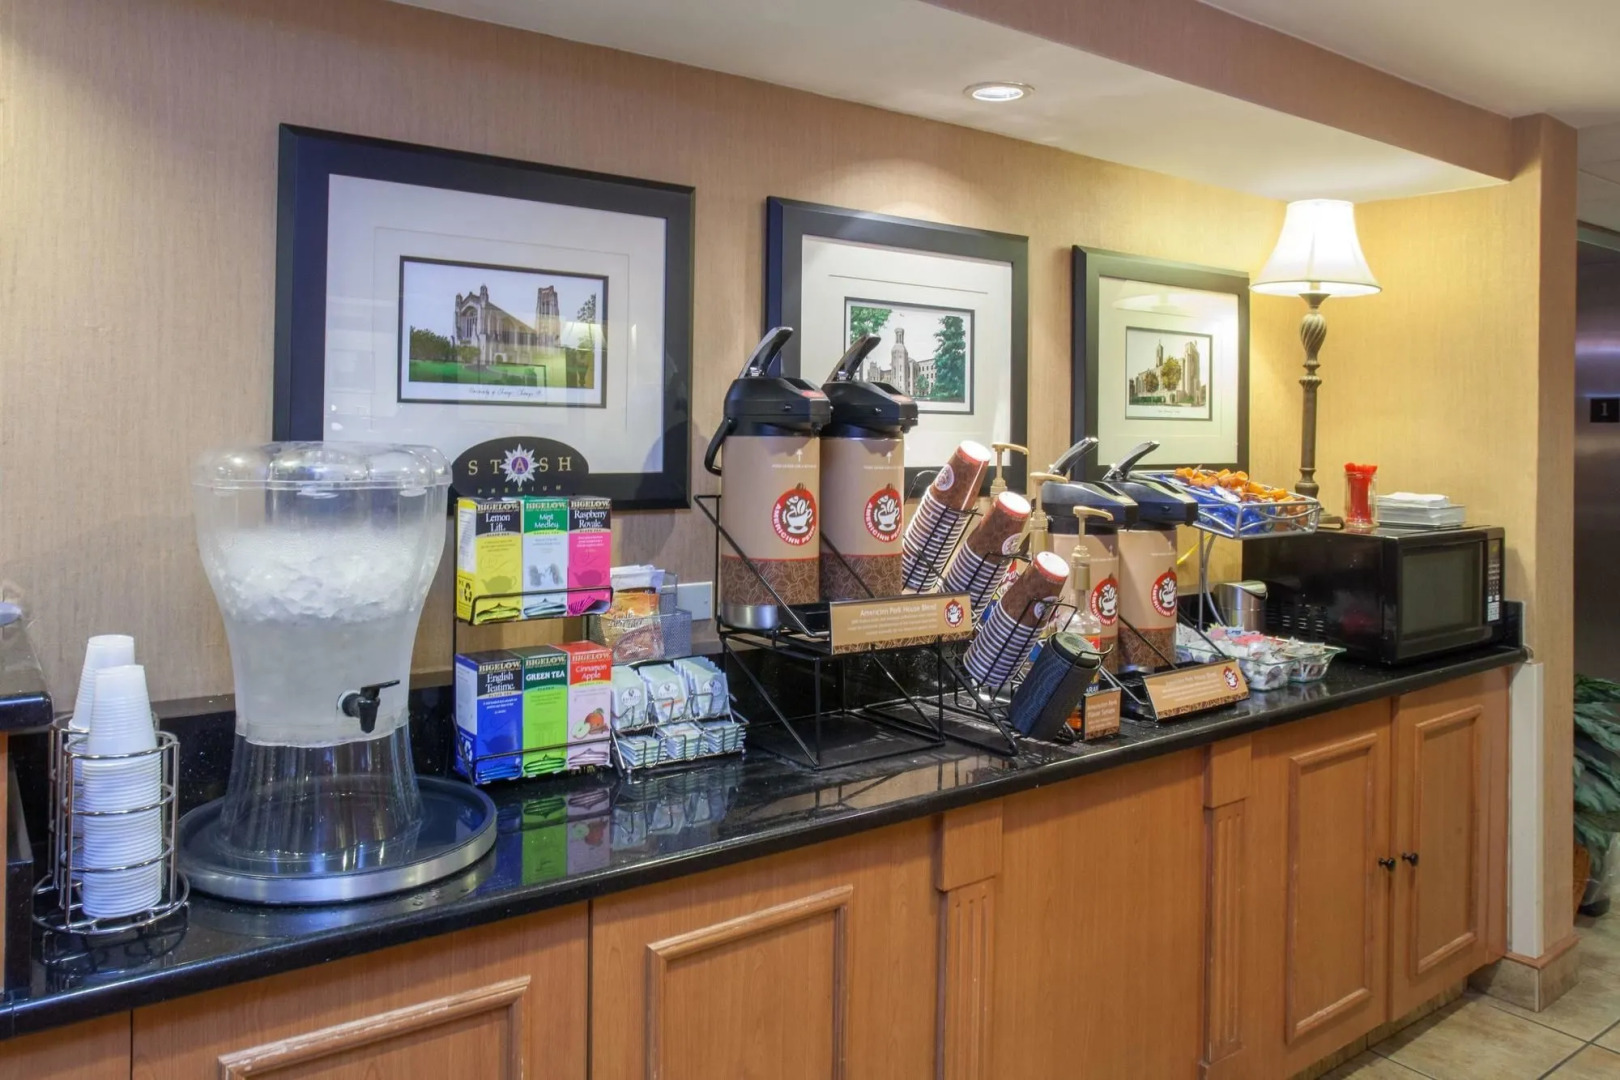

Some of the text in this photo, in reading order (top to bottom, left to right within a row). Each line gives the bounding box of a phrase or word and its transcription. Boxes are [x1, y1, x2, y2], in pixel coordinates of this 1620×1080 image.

[1600, 402, 1608, 416] 1
[468, 457, 572, 475] STASH
[477, 485, 562, 494] PREMIUM
[477, 502, 519, 511] BIGELOW
[526, 501, 567, 510] BIGELOW
[571, 500, 610, 508] BIGELOW
[485, 513, 511, 523] Lemon
[574, 509, 608, 520] Raspberry
[534, 520, 559, 530] Medley
[525, 656, 566, 666] BIGELOW
[572, 652, 611, 661] BIGELOW
[479, 661, 521, 672] BIGELOW
[575, 663, 608, 673] Cinnamon
[487, 672, 514, 684] English
[525, 670, 566, 682] GREEN TEA
[581, 672, 602, 682] Apple
[485, 682, 515, 693] Teatime
